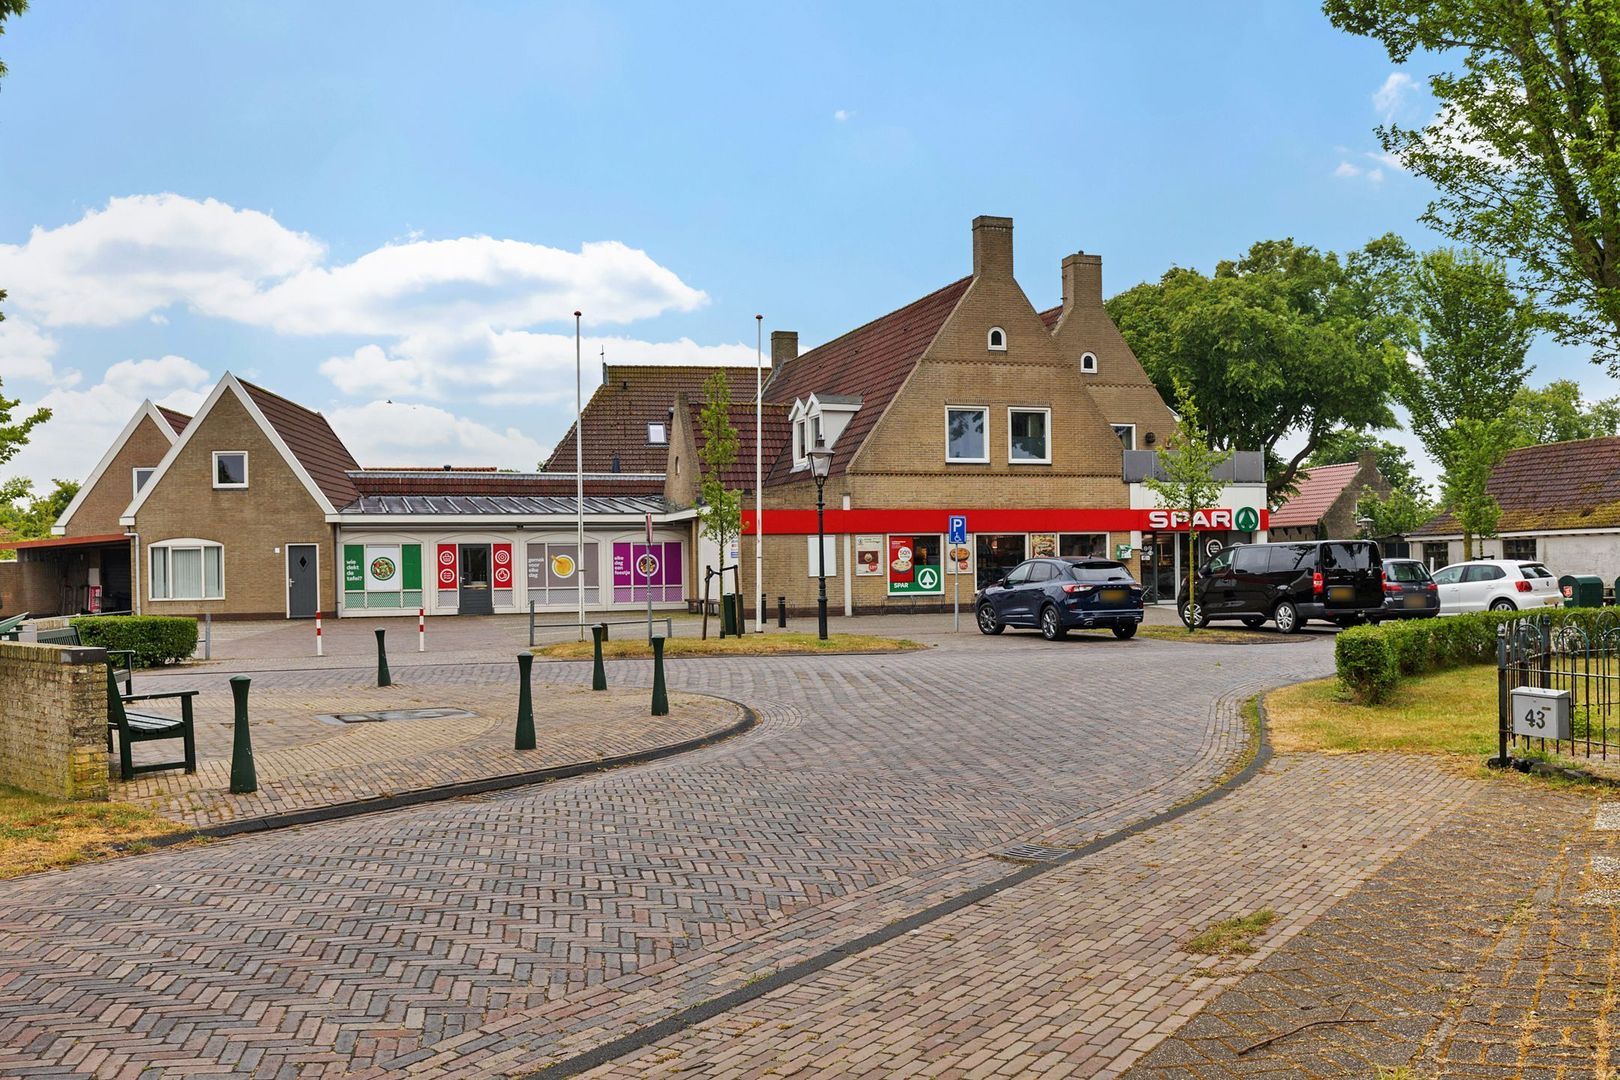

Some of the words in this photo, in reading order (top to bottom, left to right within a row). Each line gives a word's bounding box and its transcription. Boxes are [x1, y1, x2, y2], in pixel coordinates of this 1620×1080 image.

[953, 518, 963, 532] P
[1149, 511, 1231, 528] SPAR
[1525, 709, 1545, 729] 43
